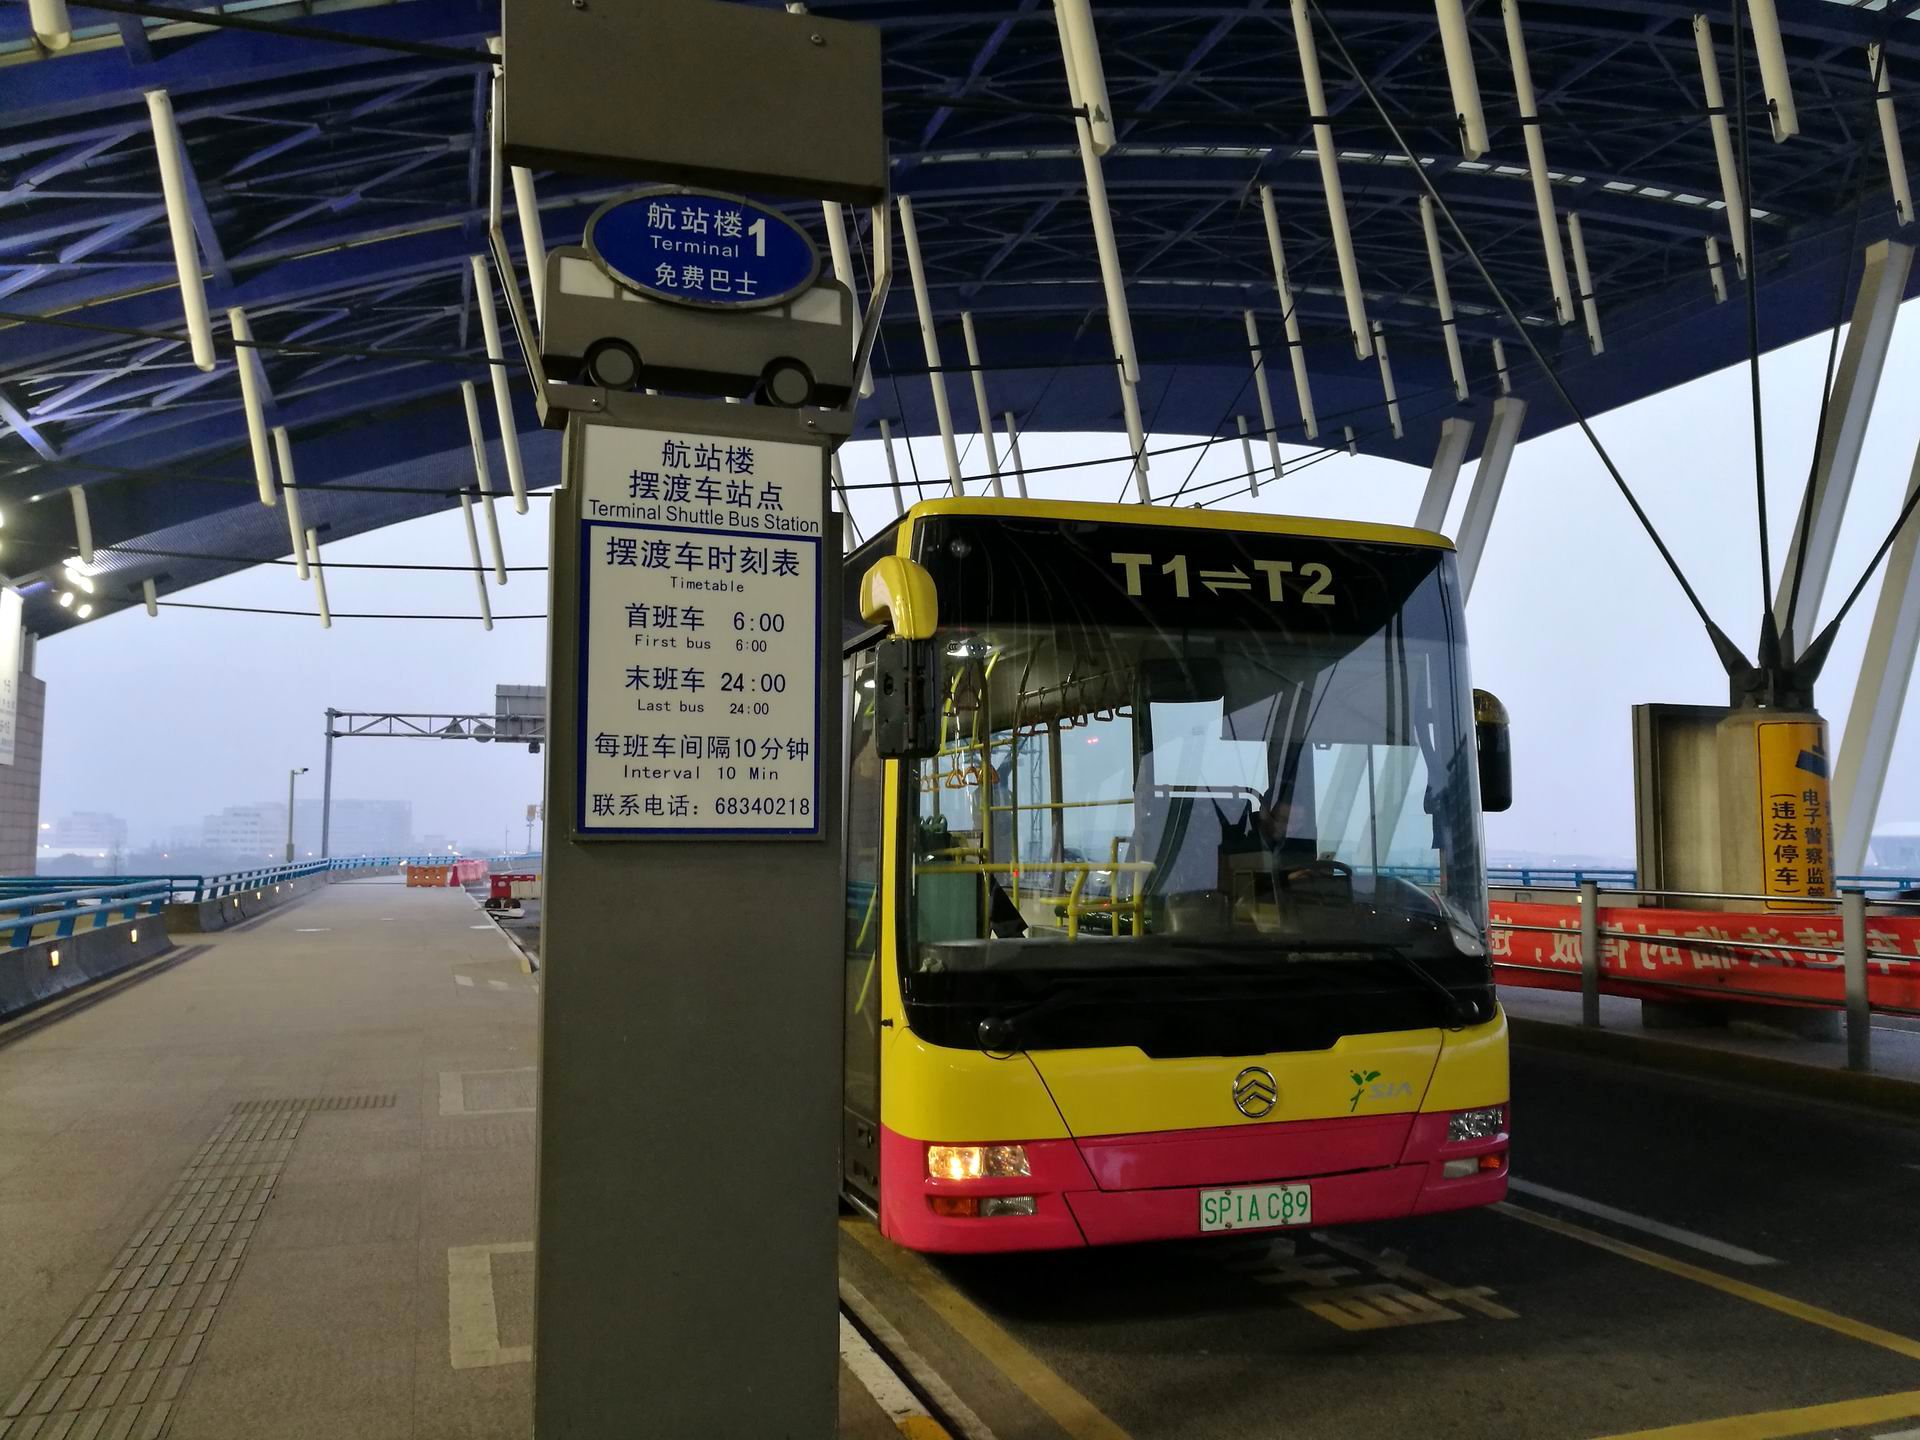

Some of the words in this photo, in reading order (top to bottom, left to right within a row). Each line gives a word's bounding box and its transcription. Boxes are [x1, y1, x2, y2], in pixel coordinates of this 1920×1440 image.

[647, 202, 743, 239] 航站楼
[748, 218, 766, 257] 1
[649, 235, 740, 258] Terminal
[654, 262, 758, 296] 免费巴士
[661, 440, 755, 475] 航站楼
[629, 470, 784, 511] 摆渡车站点
[589, 500, 661, 521] Terminal
[666, 506, 724, 525] Shuttle
[729, 512, 759, 528] Bus
[764, 514, 819, 533] Station
[606, 536, 800, 577] 摆渡车时刻表
[671, 576, 744, 593] Timetable
[1111, 552, 1190, 598] T1
[1253, 559, 1336, 605] T2
[625, 603, 705, 631] 首班车
[733, 611, 785, 632] 6:00
[635, 634, 677, 648] First
[686, 637, 711, 650] bus
[735, 639, 767, 653] 6:00
[625, 665, 705, 693] 末班车
[720, 672, 786, 693] 24:00
[637, 699, 671, 712] Last
[679, 701, 704, 713] bus
[730, 703, 769, 716] 24:00
[594, 732, 809, 762] 每班车间隔10分钟
[624, 765, 700, 780] Interval
[718, 767, 736, 780] 10
[749, 767, 779, 781] Min
[715, 797, 810, 816] 68340218
[1204, 1194, 1260, 1225] SPIA
[1267, 1190, 1309, 1219] C89
